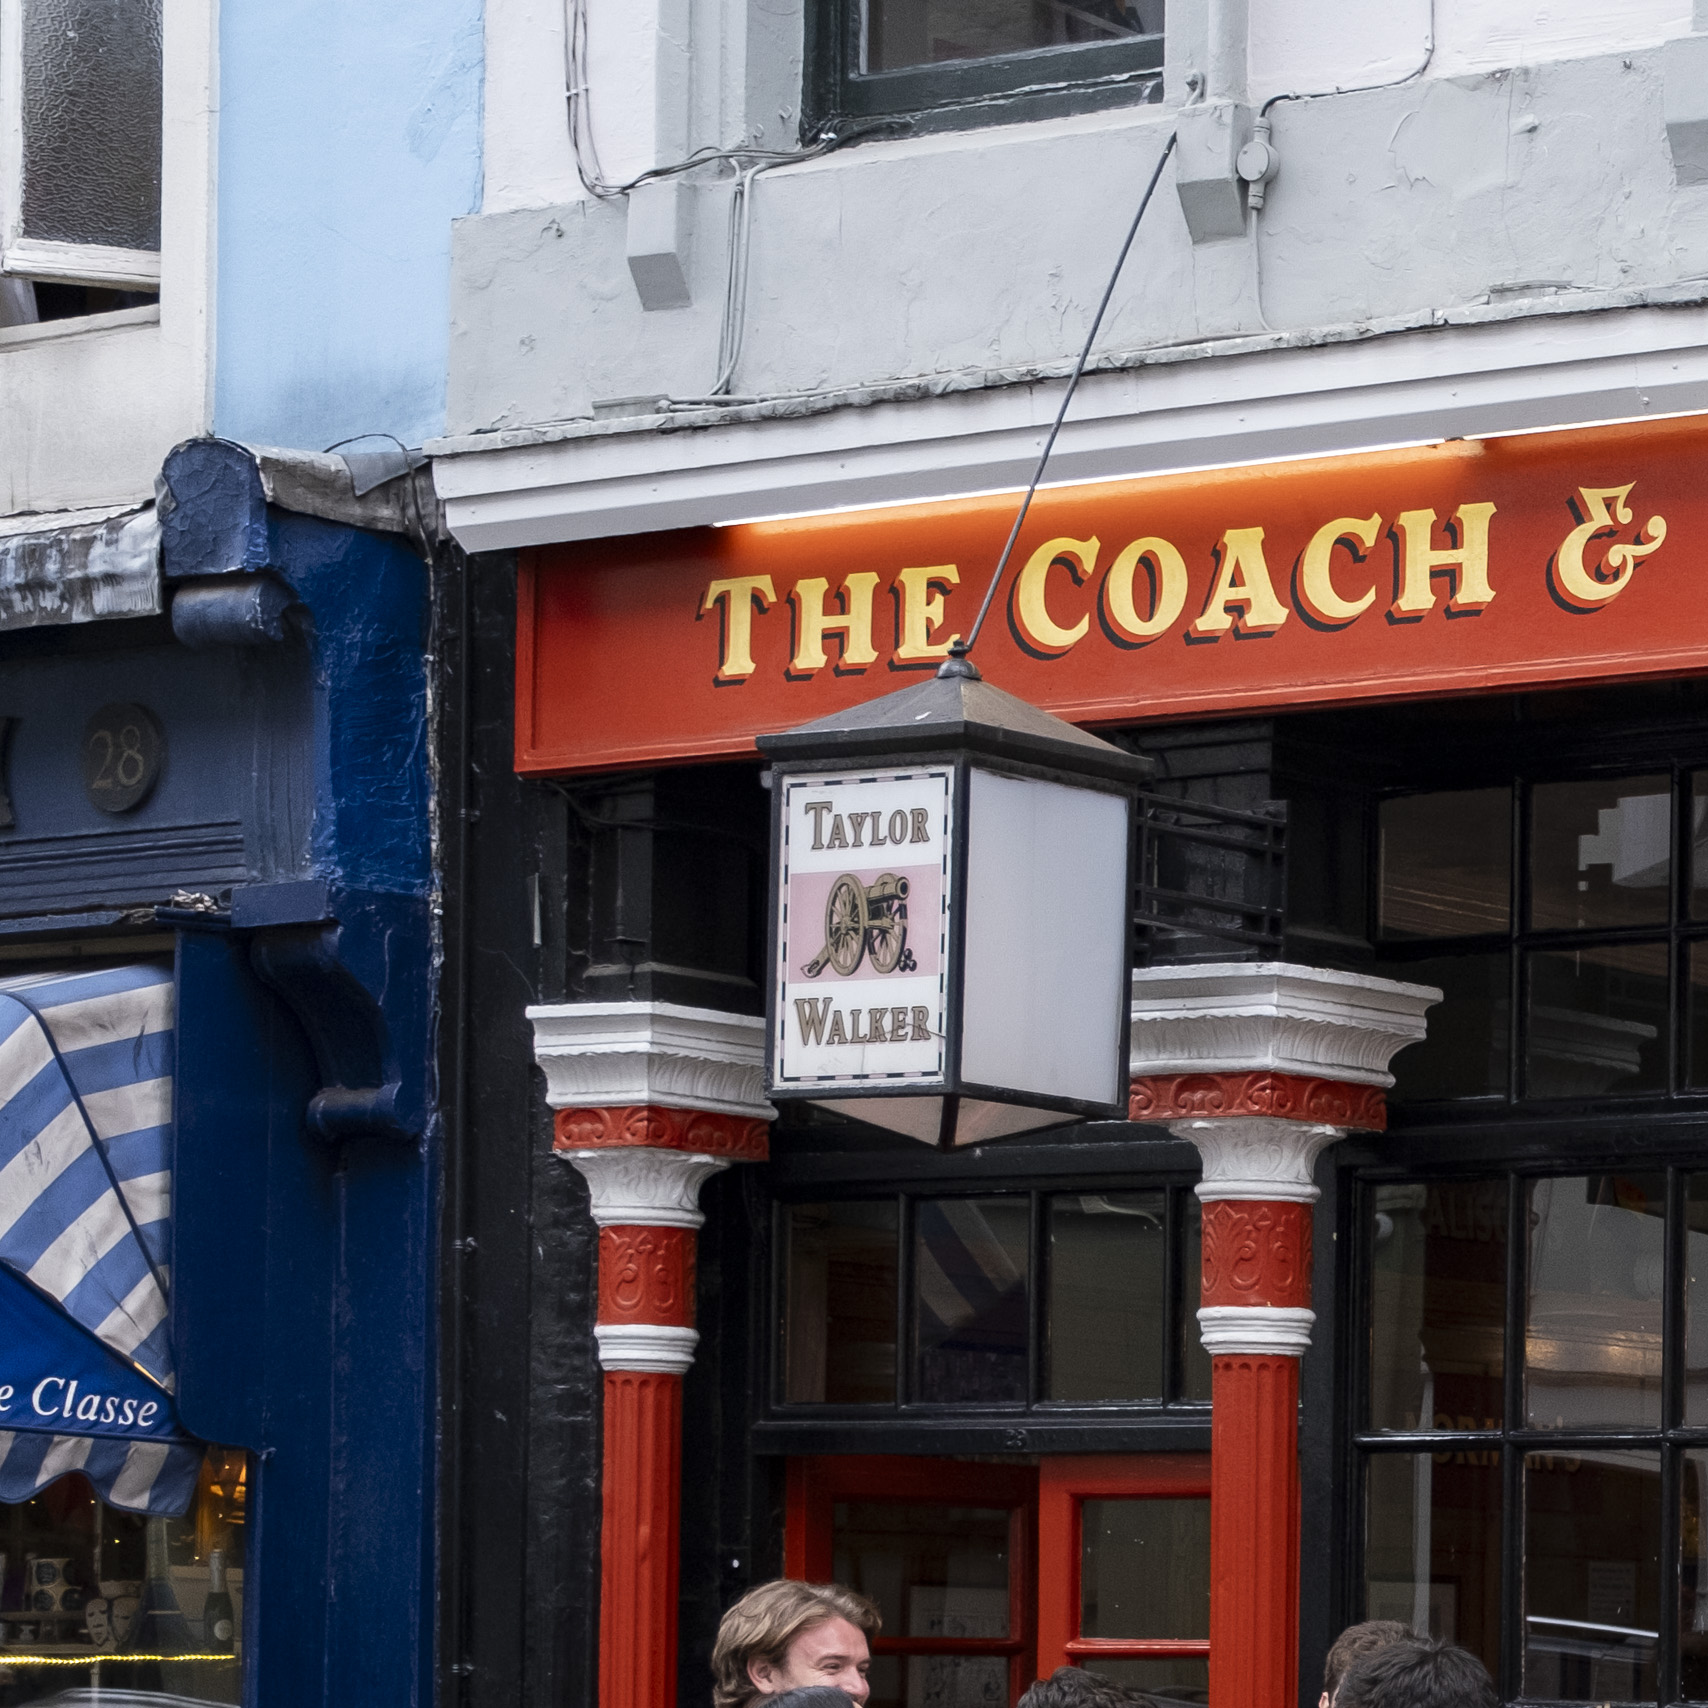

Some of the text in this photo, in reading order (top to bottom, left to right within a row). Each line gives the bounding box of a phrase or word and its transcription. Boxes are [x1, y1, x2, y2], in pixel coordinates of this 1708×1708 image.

[701, 564, 962, 682] THE
[1010, 501, 1497, 655] COACH
[1550, 480, 1667, 608] &
[89, 724, 144, 790] 28
[805, 801, 931, 852] TAYLOR
[795, 996, 932, 1049] WALKER
[32, 1377, 158, 1426] Classe
